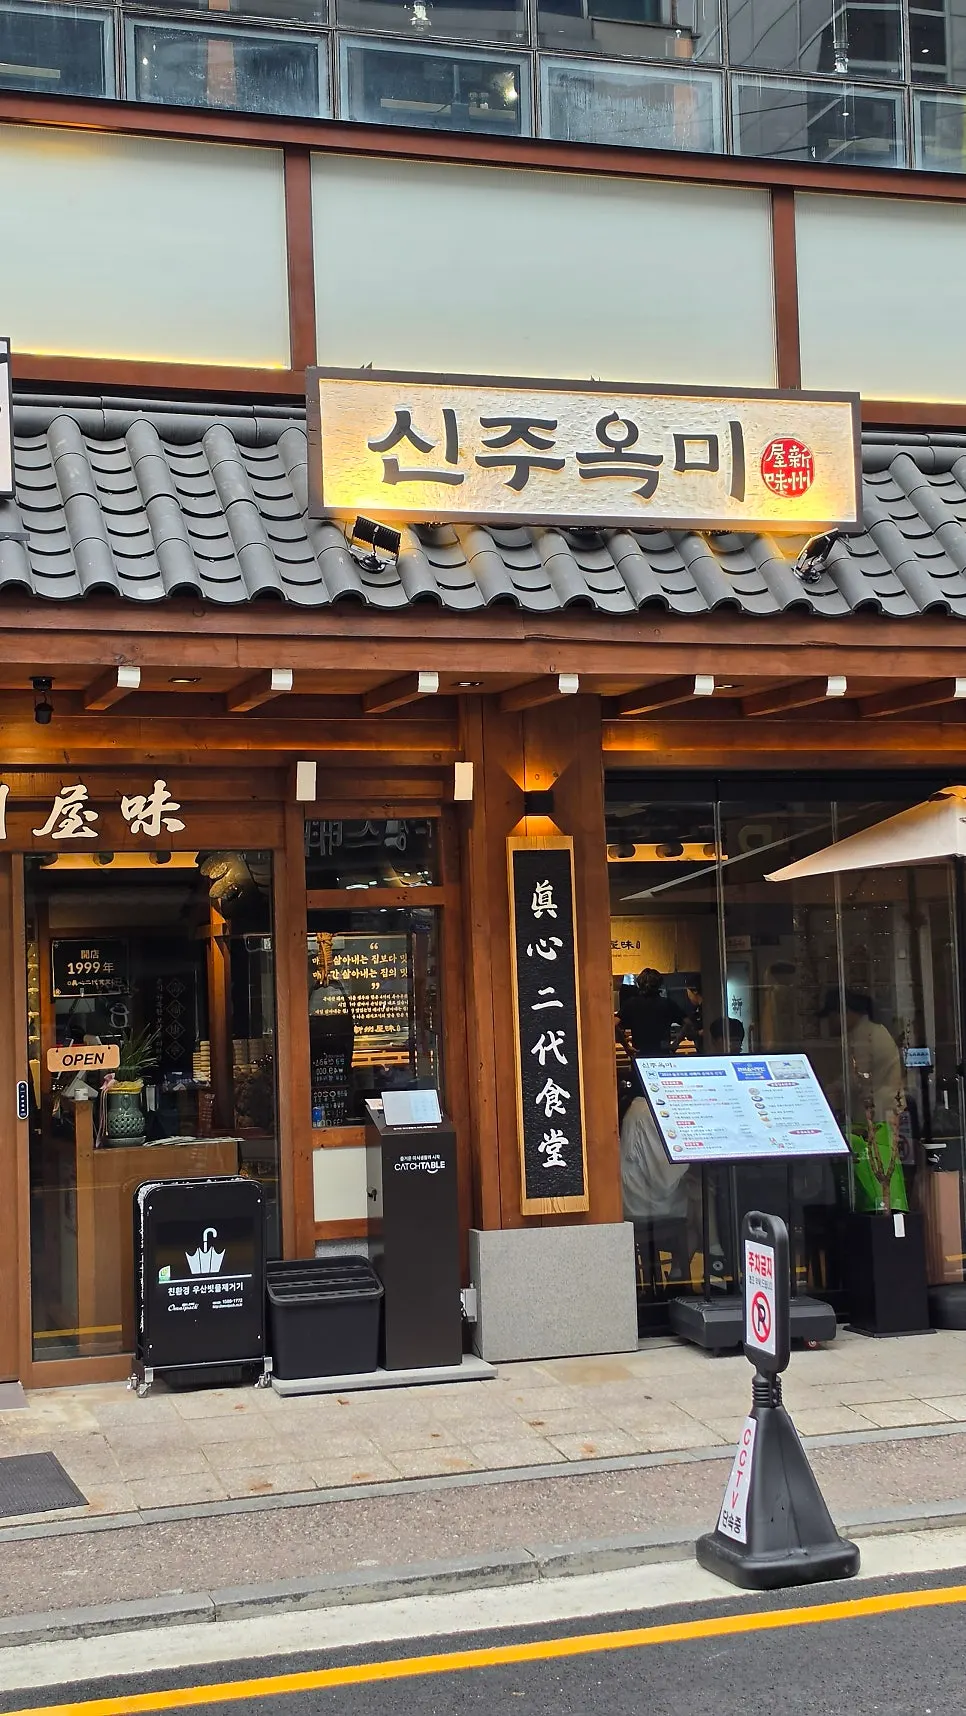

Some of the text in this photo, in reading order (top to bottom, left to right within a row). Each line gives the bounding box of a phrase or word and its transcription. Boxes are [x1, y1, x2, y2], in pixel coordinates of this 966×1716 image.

[367, 407, 746, 503] 신주옥미
[0, 779, 186, 840] 屋味
[62, 1052, 105, 1067] OPEN
[394, 1160, 446, 1171] CATCHTABLE
[748, 1251, 773, 1279] 주차금지
[167, 1285, 190, 1297] 친환경
[731, 1428, 752, 1509] CCTV
[722, 1510, 742, 1534] 단속중
